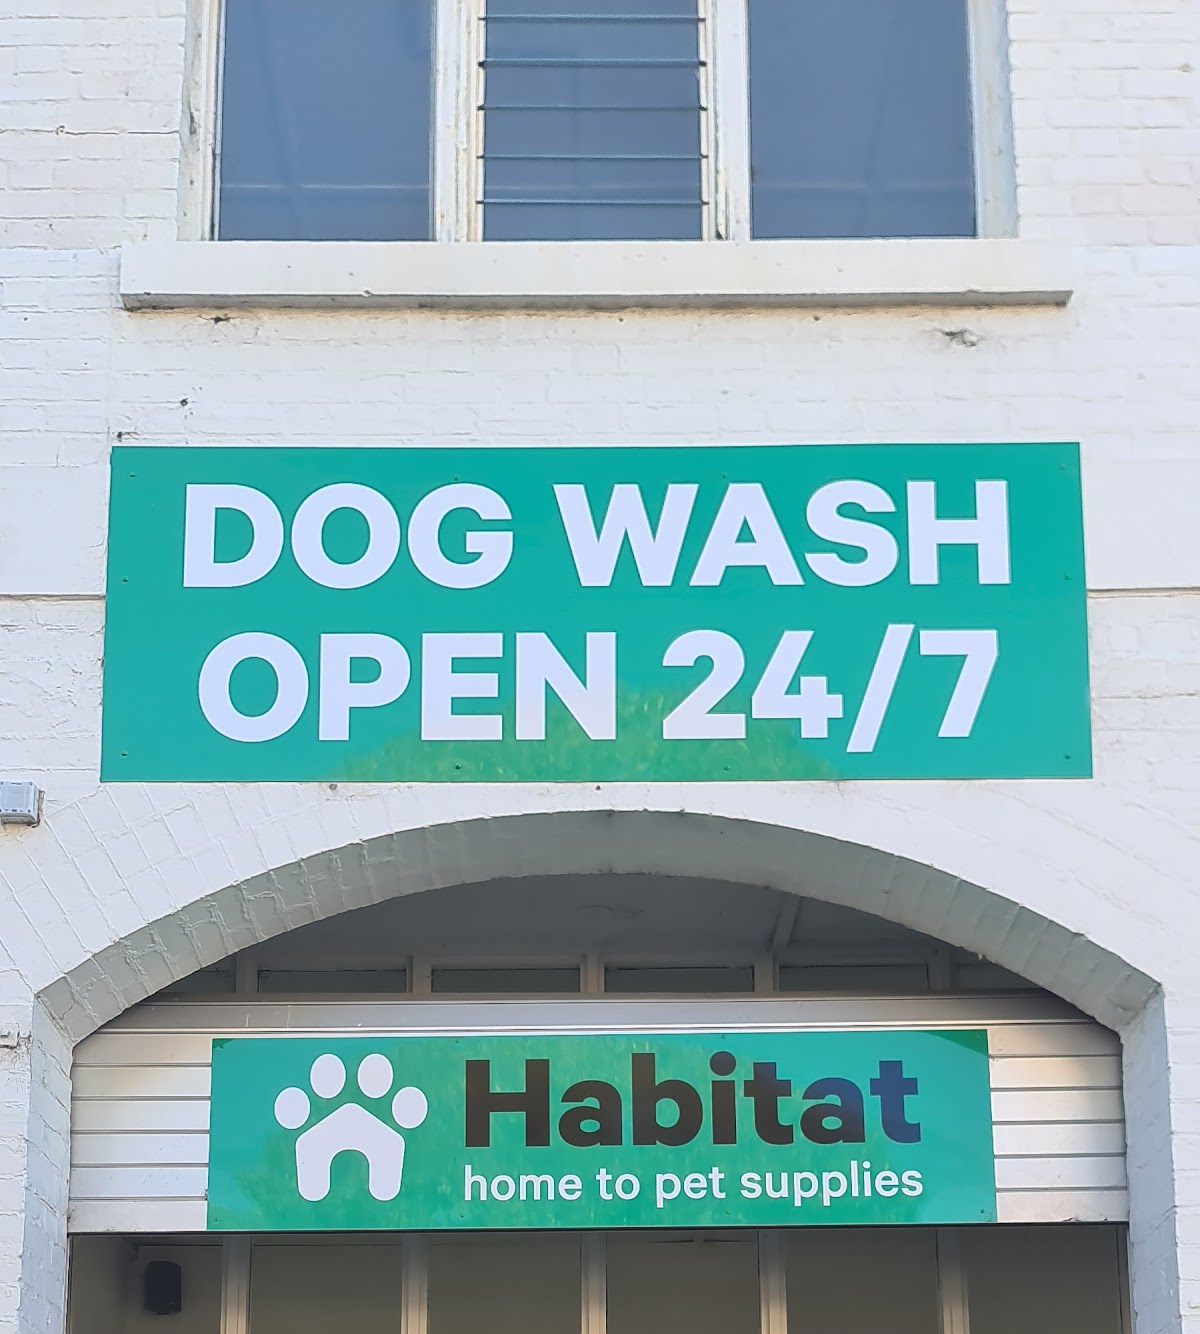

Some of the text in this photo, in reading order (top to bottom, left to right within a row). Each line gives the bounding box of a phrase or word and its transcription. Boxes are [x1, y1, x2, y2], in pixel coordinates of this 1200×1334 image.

[183, 480, 1011, 589] DOG WASH
[198, 623, 998, 753] OPEN 24/7
[465, 1050, 922, 1149] Habitat
[464, 1160, 923, 1208] home to pet supplies
